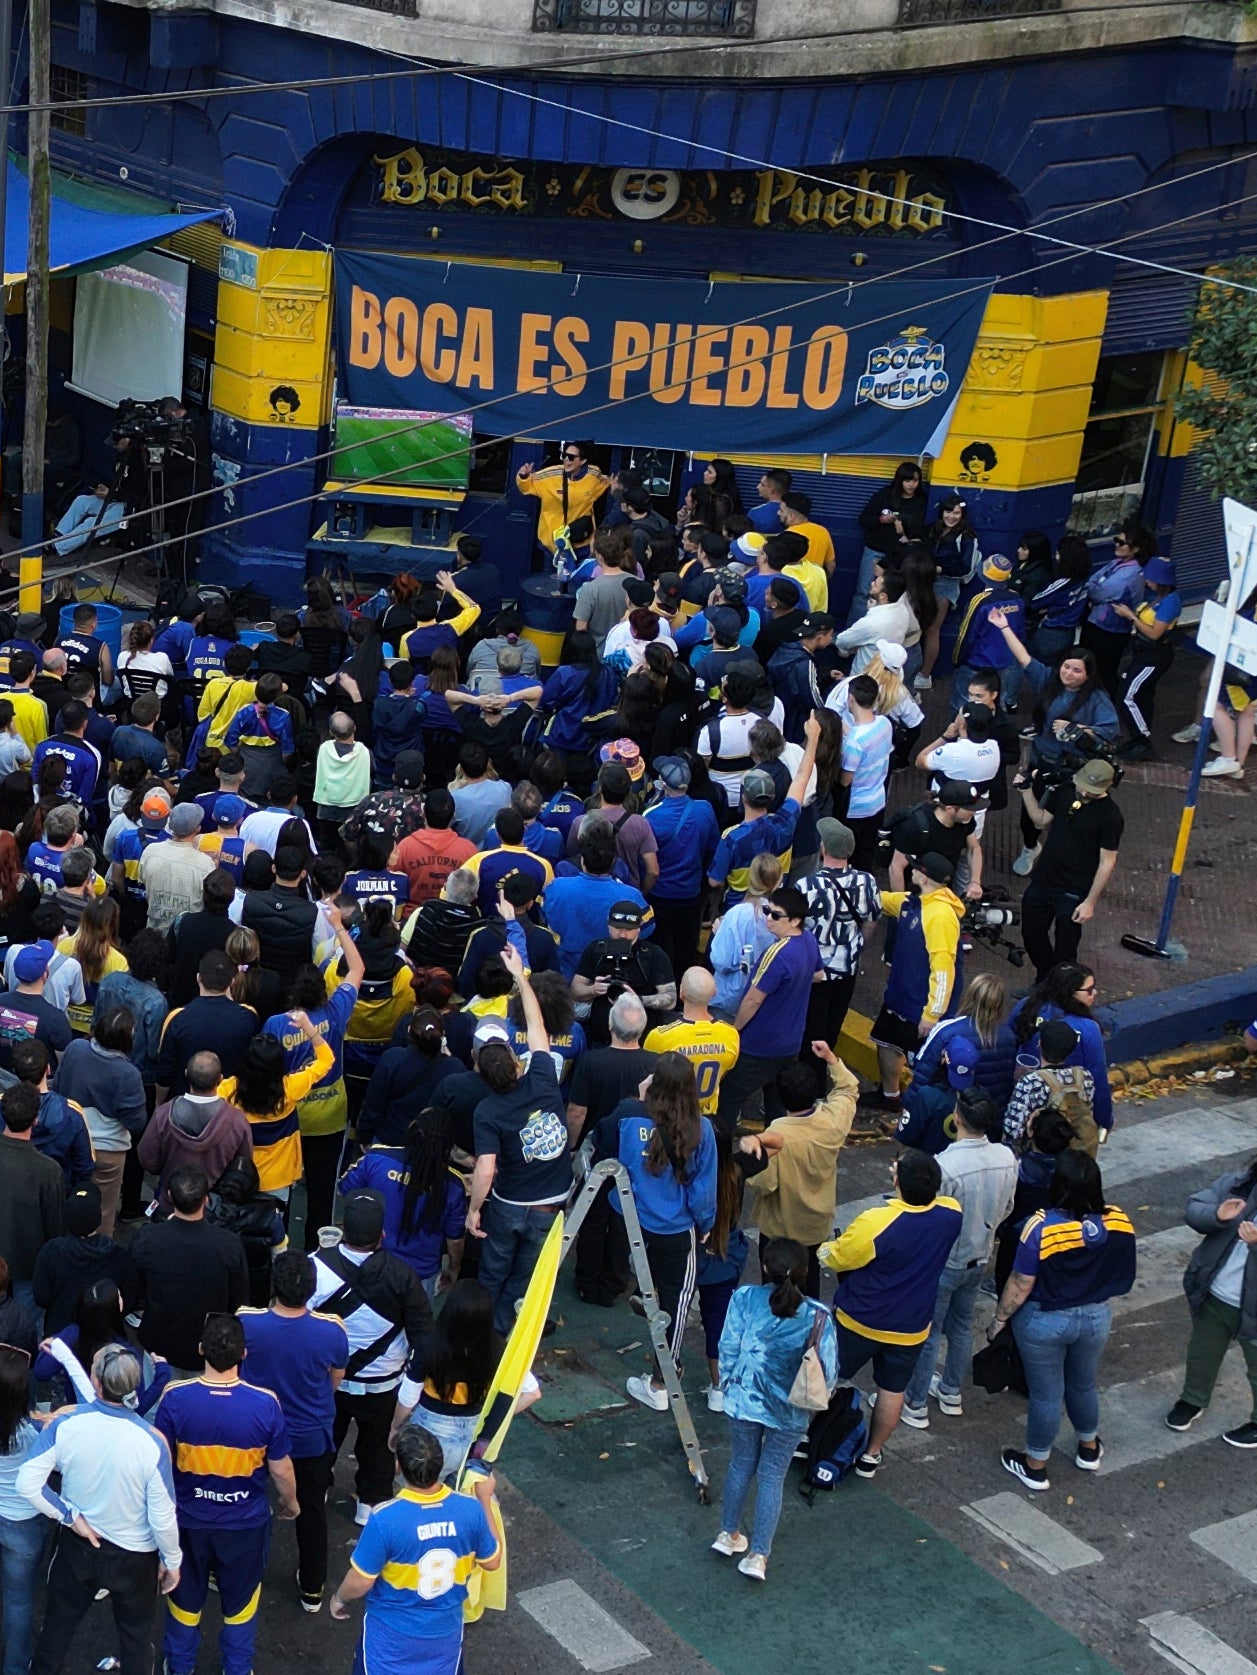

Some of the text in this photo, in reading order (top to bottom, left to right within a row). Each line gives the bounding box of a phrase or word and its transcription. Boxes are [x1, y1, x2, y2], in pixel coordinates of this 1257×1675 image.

[373, 146, 529, 209] Boca
[621, 173, 669, 205] ES
[753, 169, 947, 233] Pueblo
[348, 284, 850, 411] BOCA ES PUEBLO
[869, 344, 945, 374] BOCA
[854, 369, 949, 405] PUEBLO
[60, 639, 90, 655] adidas
[194, 1487, 250, 1504] DIRECTV
[417, 1521, 458, 1541] GIUNTA
[417, 1547, 458, 1600] 8
